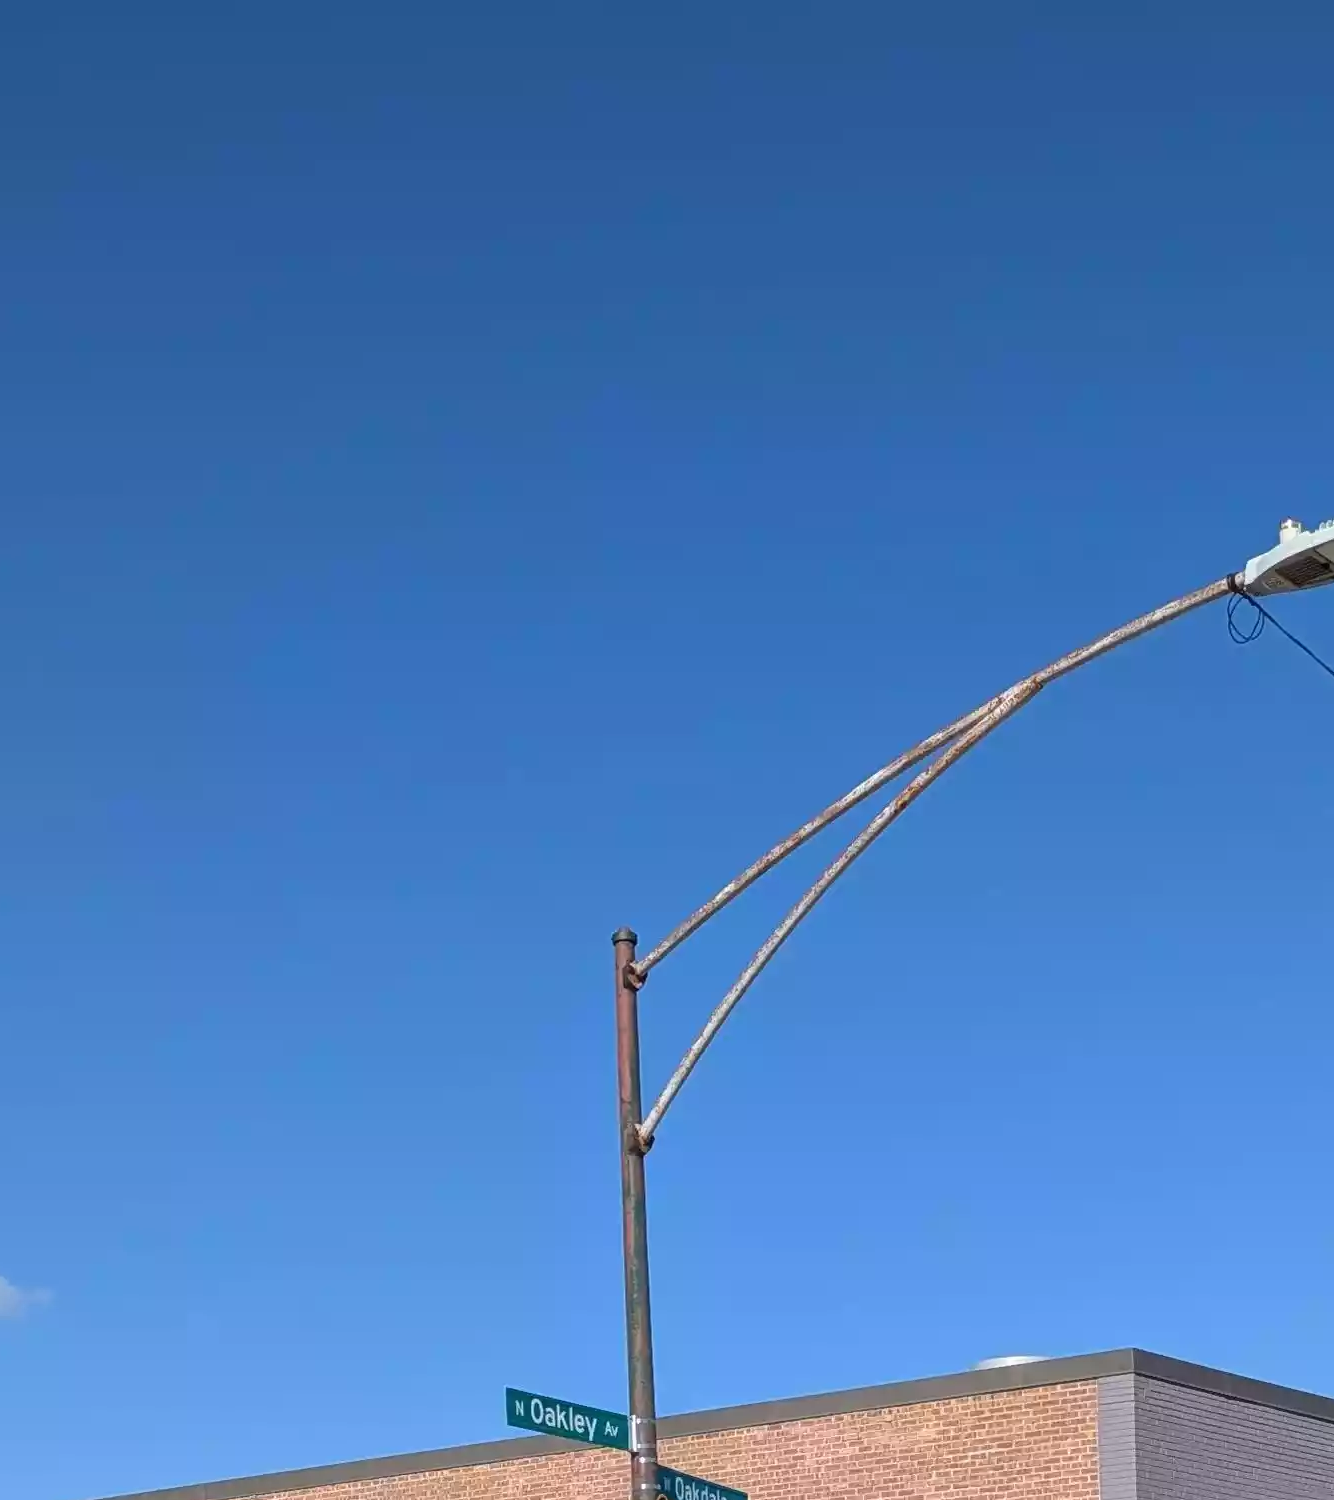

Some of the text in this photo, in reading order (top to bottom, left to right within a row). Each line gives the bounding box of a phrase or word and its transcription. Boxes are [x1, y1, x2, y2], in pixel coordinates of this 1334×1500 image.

[515, 1398, 619, 1442] N Oakley Av
